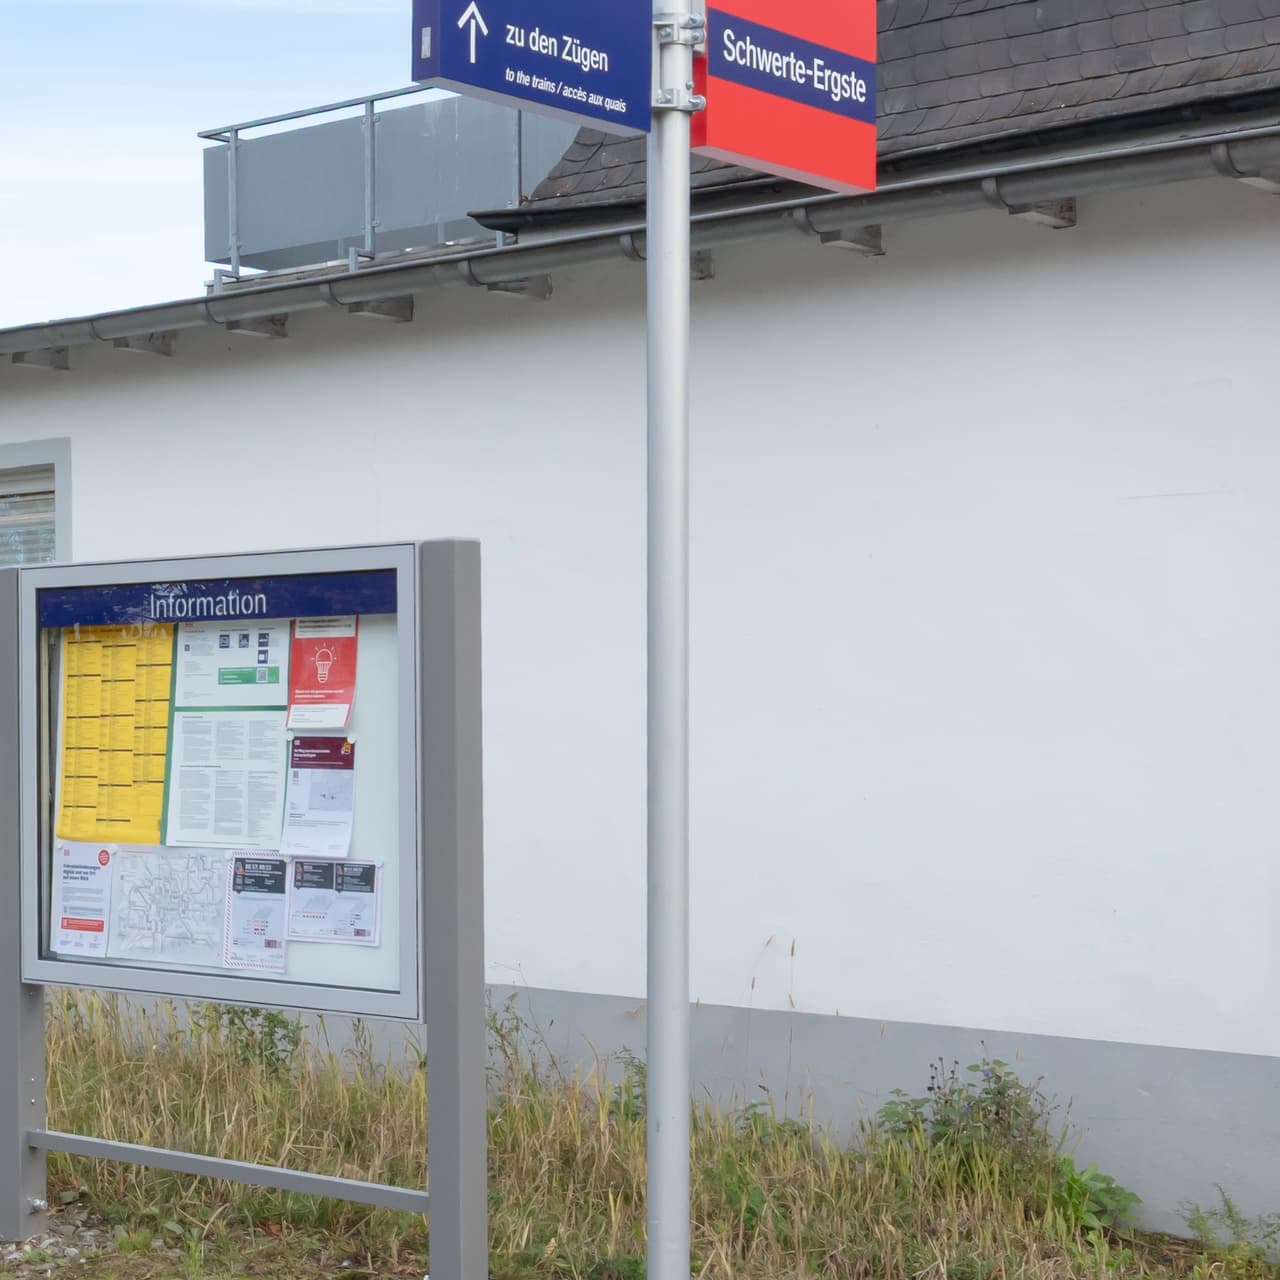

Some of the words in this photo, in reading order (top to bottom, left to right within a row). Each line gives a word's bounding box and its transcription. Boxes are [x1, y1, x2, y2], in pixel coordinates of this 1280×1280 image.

[505, 24, 525, 48] zu
[529, 27, 558, 57] den
[561, 35, 608, 72] Zügen
[723, 28, 866, 103] Schwerte-Ergste
[505, 67, 515, 82] to
[516, 70, 530, 86] the
[532, 75, 556, 94] trains
[562, 85, 587, 102] accès
[588, 93, 603, 106] aux
[604, 97, 627, 113] quais
[150, 589, 267, 618] Information
